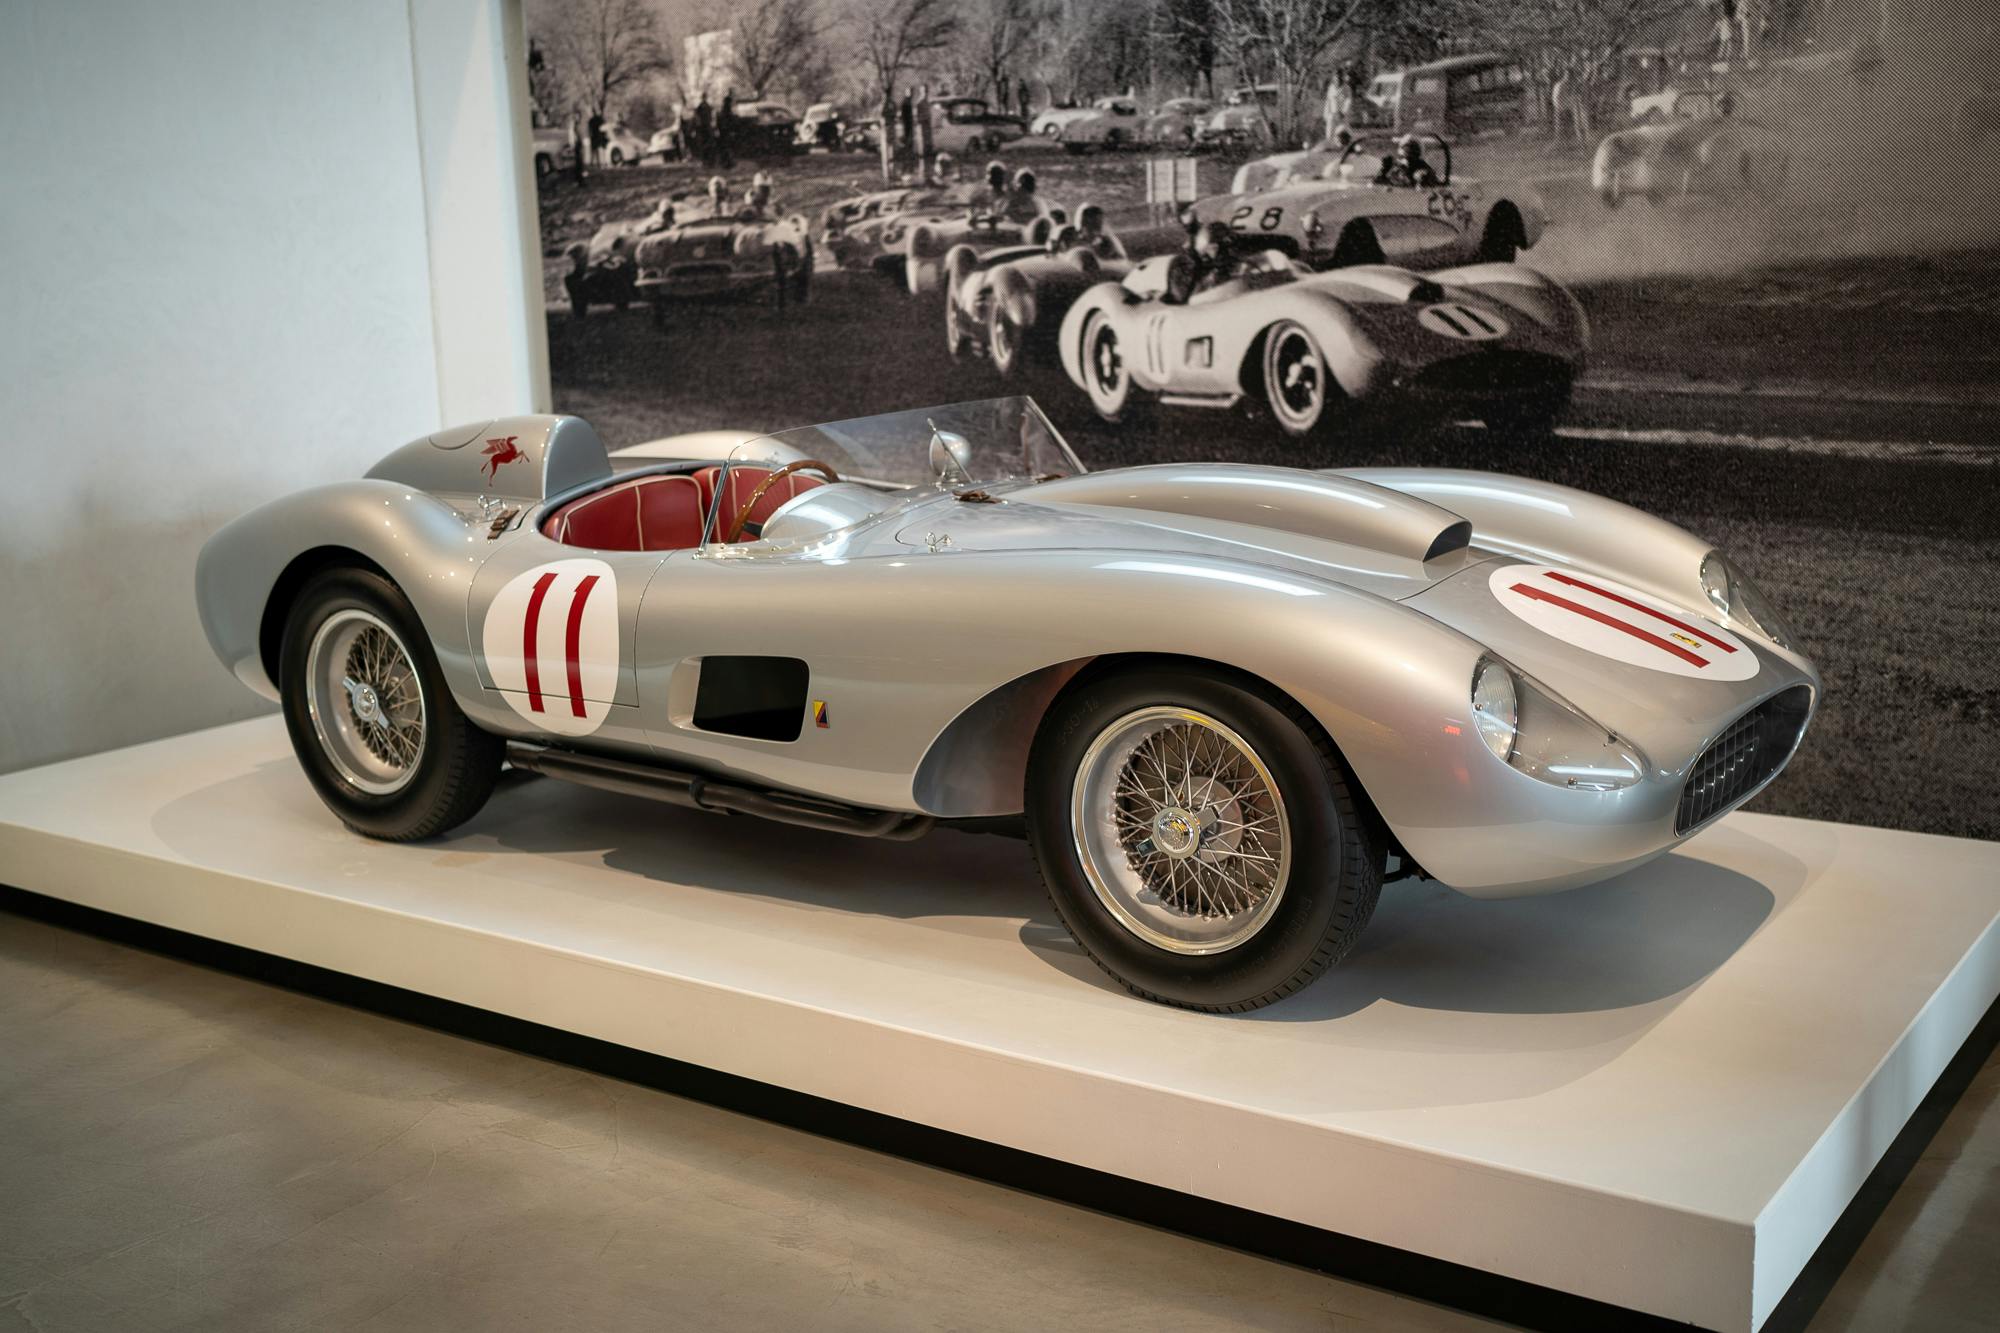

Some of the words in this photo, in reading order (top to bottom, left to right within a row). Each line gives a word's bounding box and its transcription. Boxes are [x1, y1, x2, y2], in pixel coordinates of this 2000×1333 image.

[1230, 206, 1284, 231] 28
[1146, 314, 1168, 375] 11
[1429, 305, 1498, 337] 11
[523, 572, 600, 719] 11
[1508, 571, 1738, 669] 11
